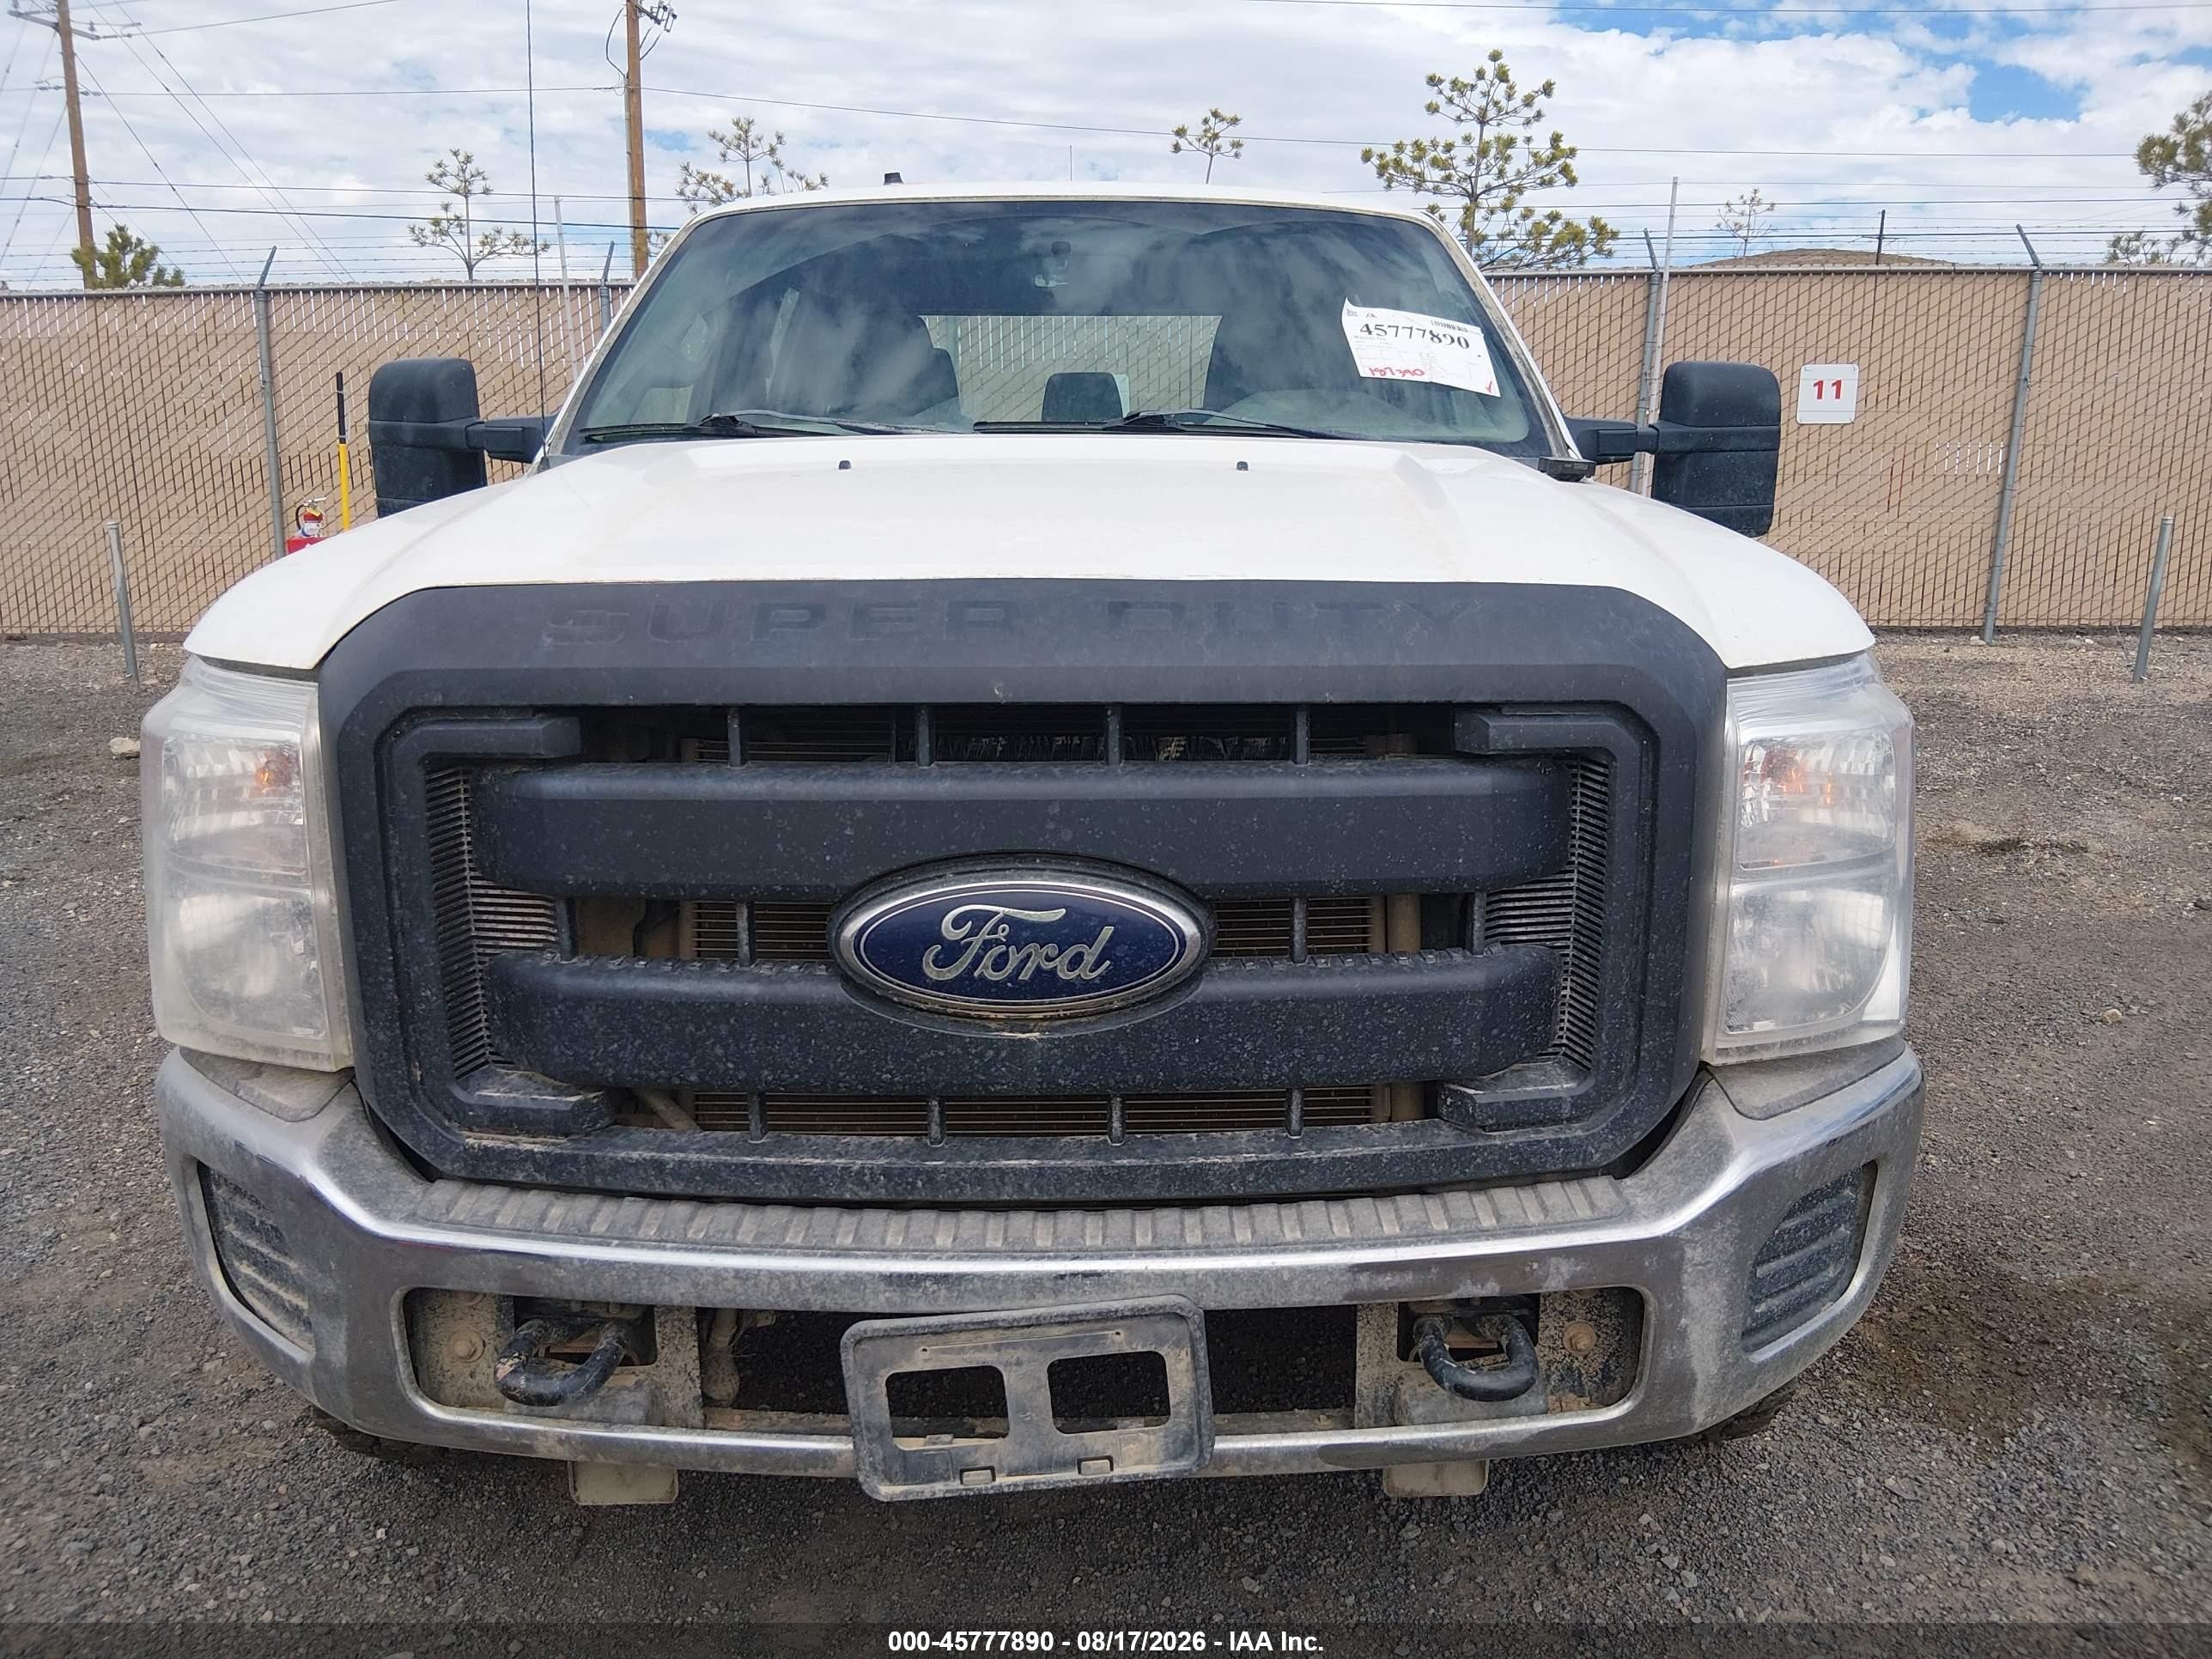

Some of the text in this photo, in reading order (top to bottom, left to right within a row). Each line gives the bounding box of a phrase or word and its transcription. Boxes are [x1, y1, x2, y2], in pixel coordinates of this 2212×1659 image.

[1359, 323, 1470, 349] 45777890
[1813, 380, 1842, 399] 11
[541, 601, 1015, 646] SUPER
[922, 904, 1115, 981] Ford
